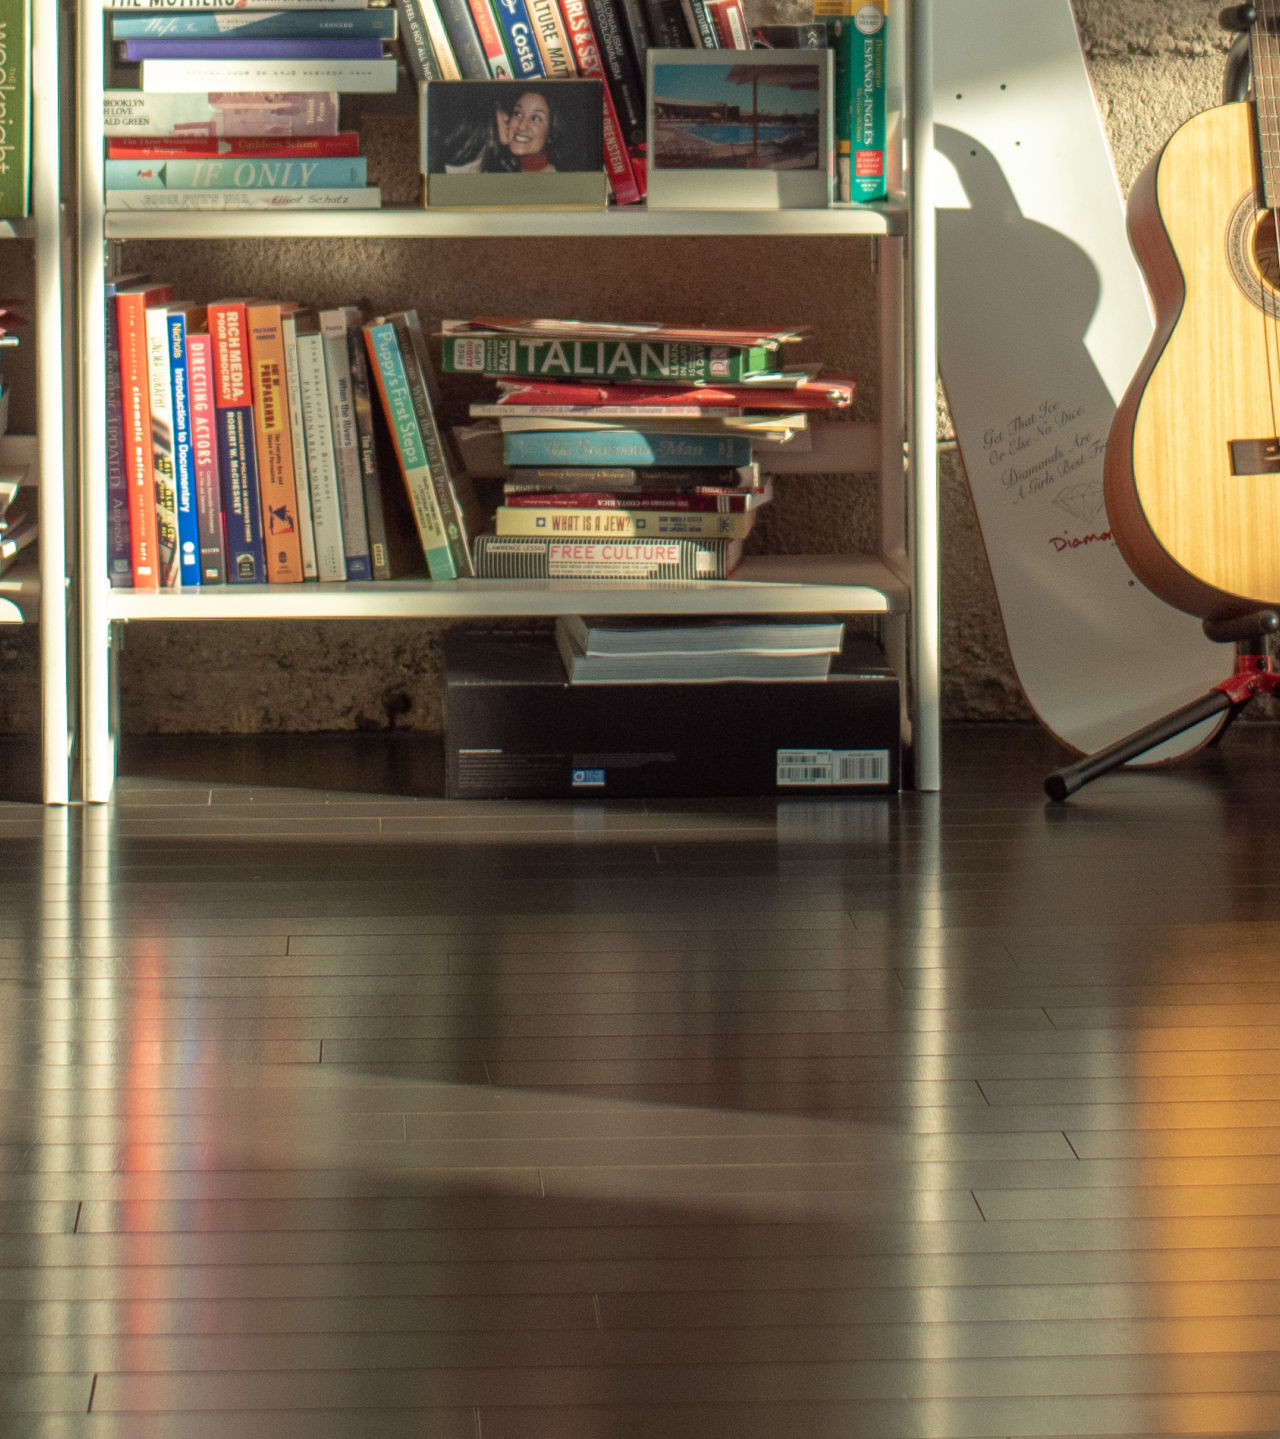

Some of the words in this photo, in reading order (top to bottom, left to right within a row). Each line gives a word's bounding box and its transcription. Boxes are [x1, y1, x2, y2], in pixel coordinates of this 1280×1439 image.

[691, 2, 709, 32] FUTURE
[511, 21, 536, 73] Costa
[121, 117, 150, 126] GREEN
[191, 162, 223, 188] IF
[233, 162, 320, 188] ONLY
[172, 323, 184, 359] Nichols
[217, 312, 227, 339] POOR
[227, 311, 242, 347] RICH
[219, 341, 232, 400] DEMOCRACY
[376, 330, 404, 386] Puppy's
[464, 341, 473, 368] AUDIO
[509, 338, 672, 377] ITALIAN
[190, 342, 209, 411] DIRECTING
[132, 386, 144, 443] cinematic
[174, 367, 189, 430] Introduction
[389, 388, 414, 421] First
[196, 417, 213, 465] ACTORS
[226, 411, 238, 446] ROBERT
[399, 423, 422, 465] Steps
[983, 430, 1003, 450] Get
[1009, 412, 1036, 435] That
[1008, 434, 1033, 456] Else
[1054, 406, 1084, 428] Dice
[135, 446, 146, 486] motion
[177, 444, 192, 513] Documentary
[1001, 446, 1064, 490] Diamonds
[1028, 470, 1055, 494] Girls
[1057, 455, 1086, 479] Best
[551, 515, 581, 531] WHAT
[582, 515, 592, 531] IS
[593, 515, 601, 531] A
[602, 515, 632, 532] JEW?
[548, 544, 595, 561] FREE
[601, 545, 678, 562] CULTURE
